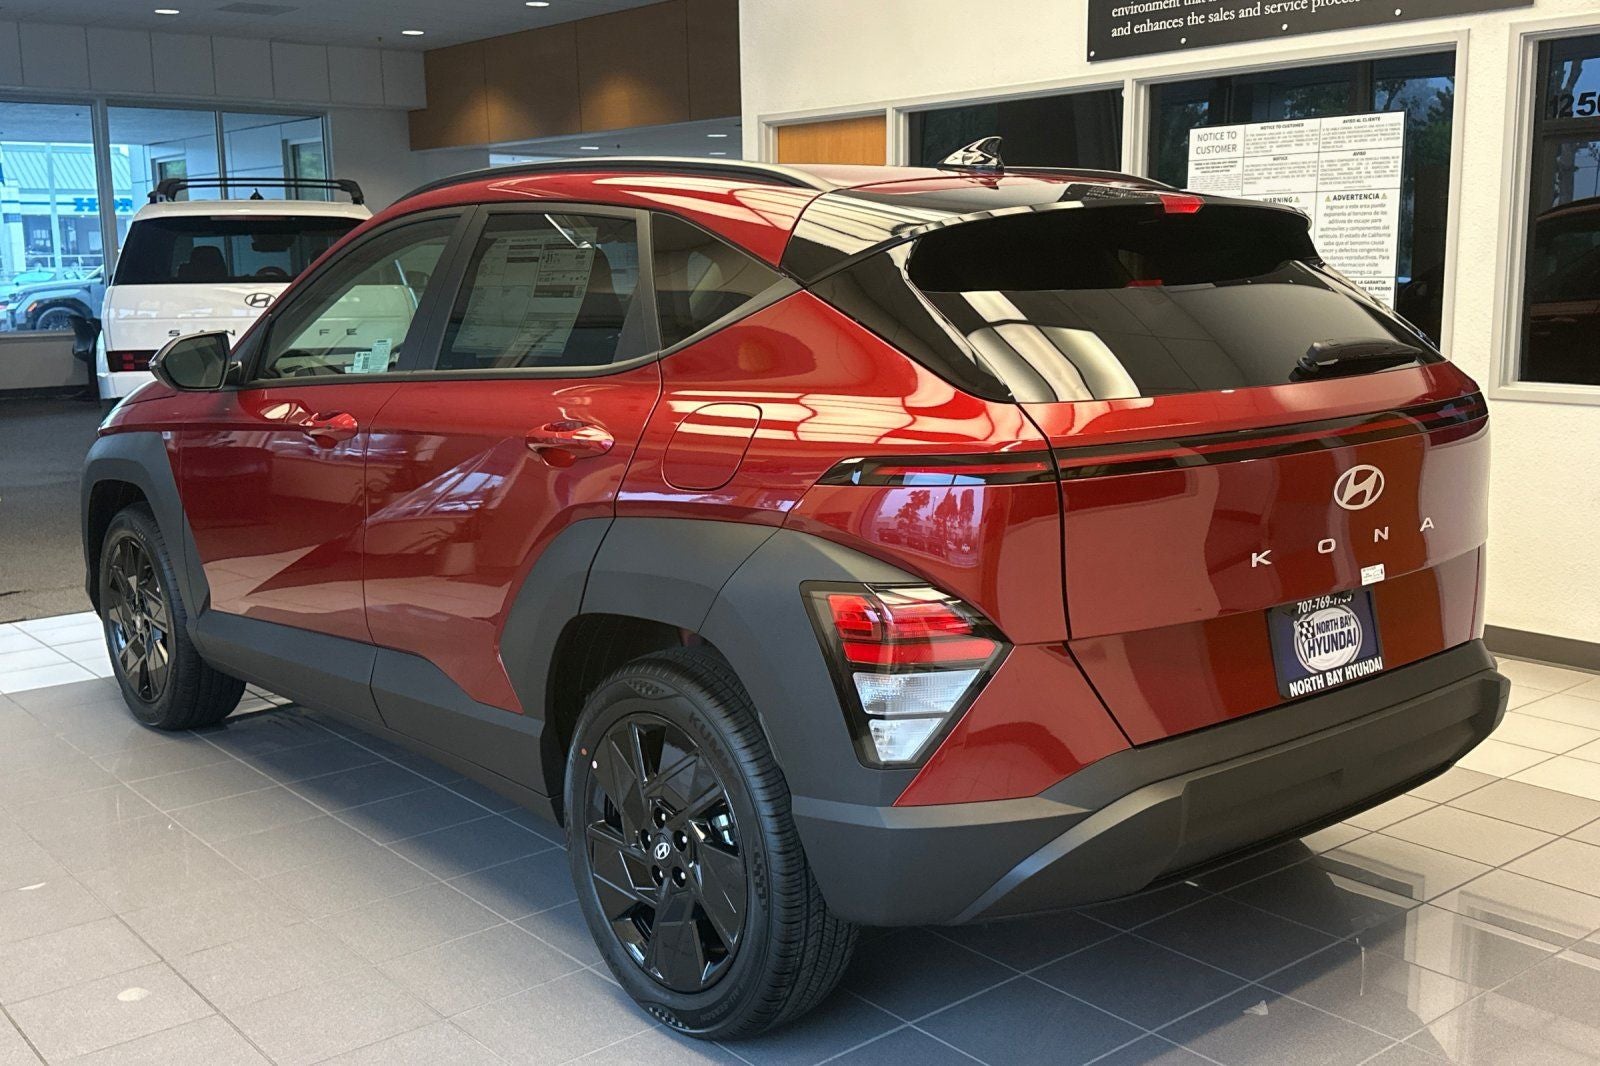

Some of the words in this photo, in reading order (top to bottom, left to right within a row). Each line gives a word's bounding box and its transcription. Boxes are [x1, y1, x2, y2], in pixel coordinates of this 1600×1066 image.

[1111, 22, 1131, 37] and
[1133, 18, 1184, 34] enhances
[1187, 12, 1205, 26] the
[1208, 7, 1235, 23] sales
[1238, 2, 1261, 19] and
[1264, 0, 1308, 15] service
[1197, 131, 1225, 142] NOTICE
[1226, 130, 1237, 139] TO
[1195, 144, 1238, 155] CUSTOMER
[1332, 193, 1380, 201] ADVERTENCIA
[1316, 619, 1339, 635] NORTH
[1340, 614, 1353, 629] BAY
[1307, 627, 1357, 659] HYUNDAI
[1289, 674, 1325, 697] NORTH
[1325, 668, 1344, 686] BAY
[1345, 656, 1384, 680] HYUNDAI
